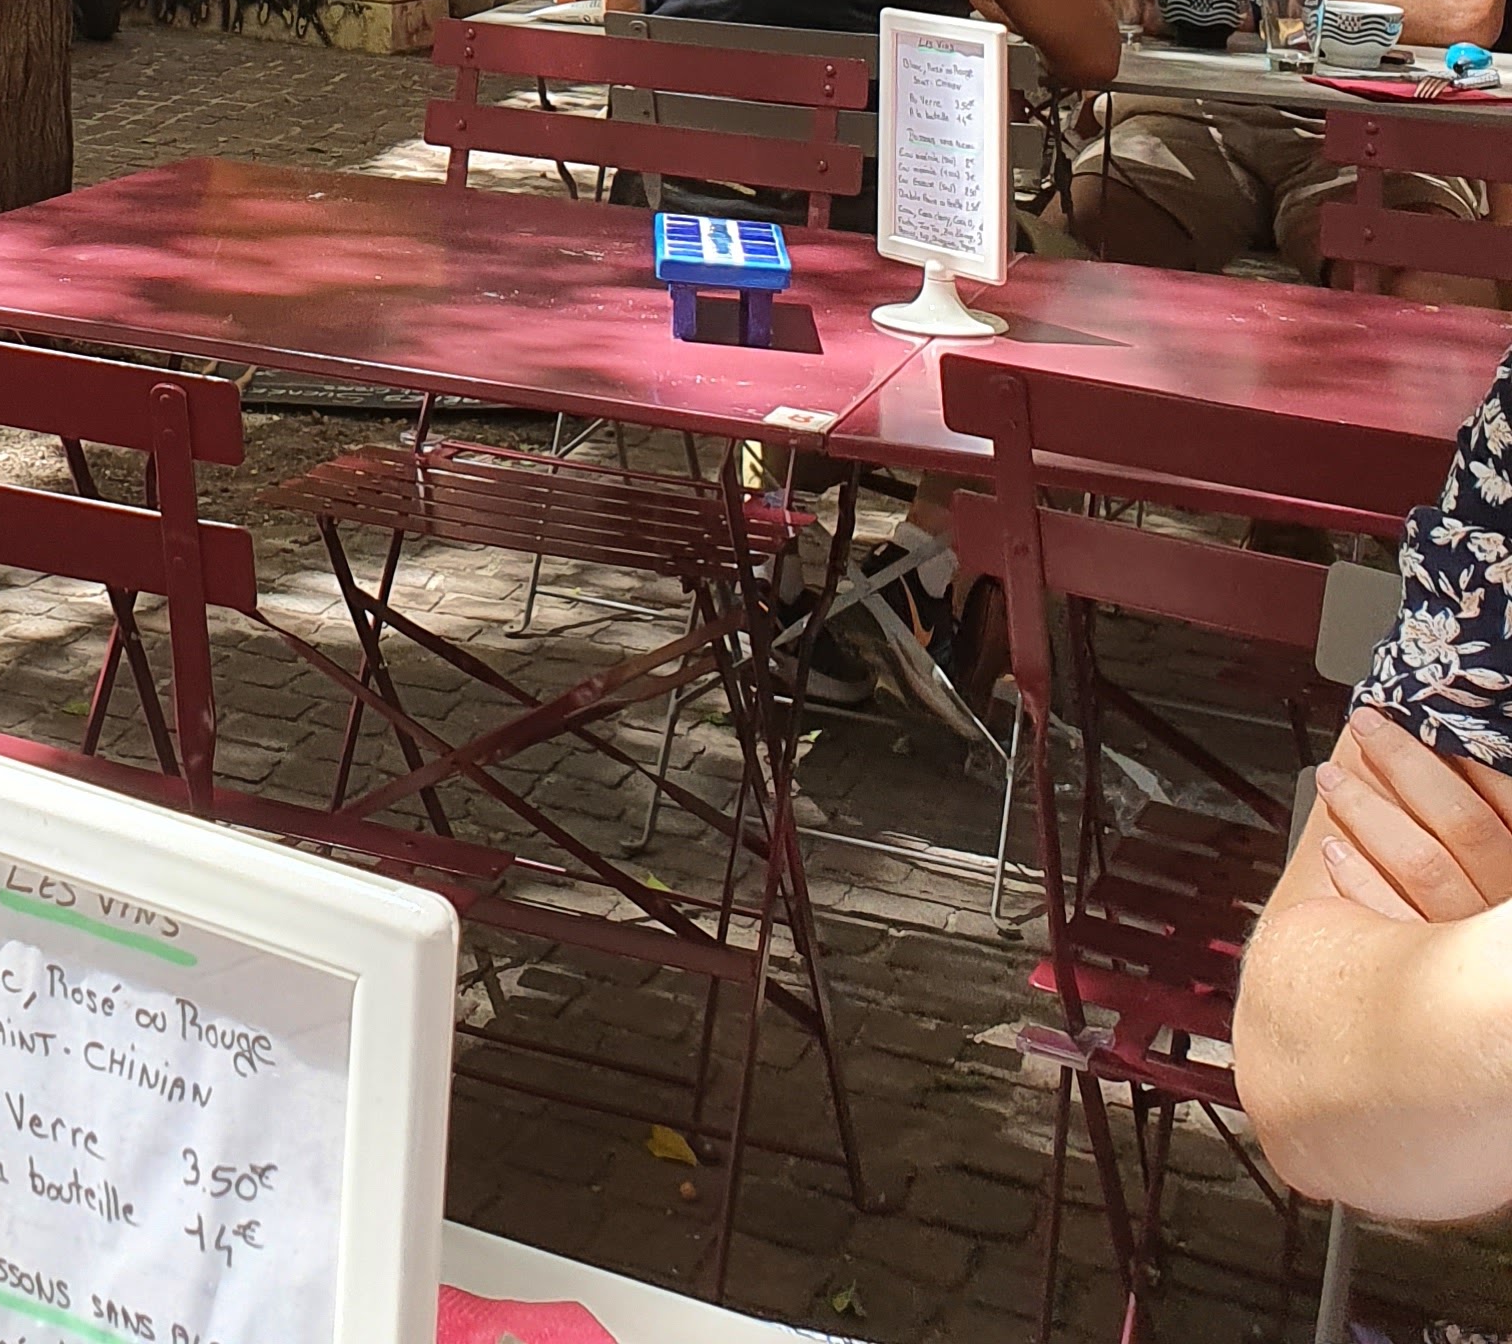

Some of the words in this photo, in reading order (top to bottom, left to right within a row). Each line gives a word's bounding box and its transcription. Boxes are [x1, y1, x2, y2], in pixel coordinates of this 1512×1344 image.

[6, 866, 76, 907] LES
[98, 894, 179, 938] VINS
[47, 964, 122, 1017] Rosé
[135, 1007, 168, 1033] ou
[176, 997, 276, 1078] Rouge
[6, 1092, 106, 1161] Verre
[29, 1156, 139, 1226] bouteille
[92, 1293, 156, 1341] SANS
